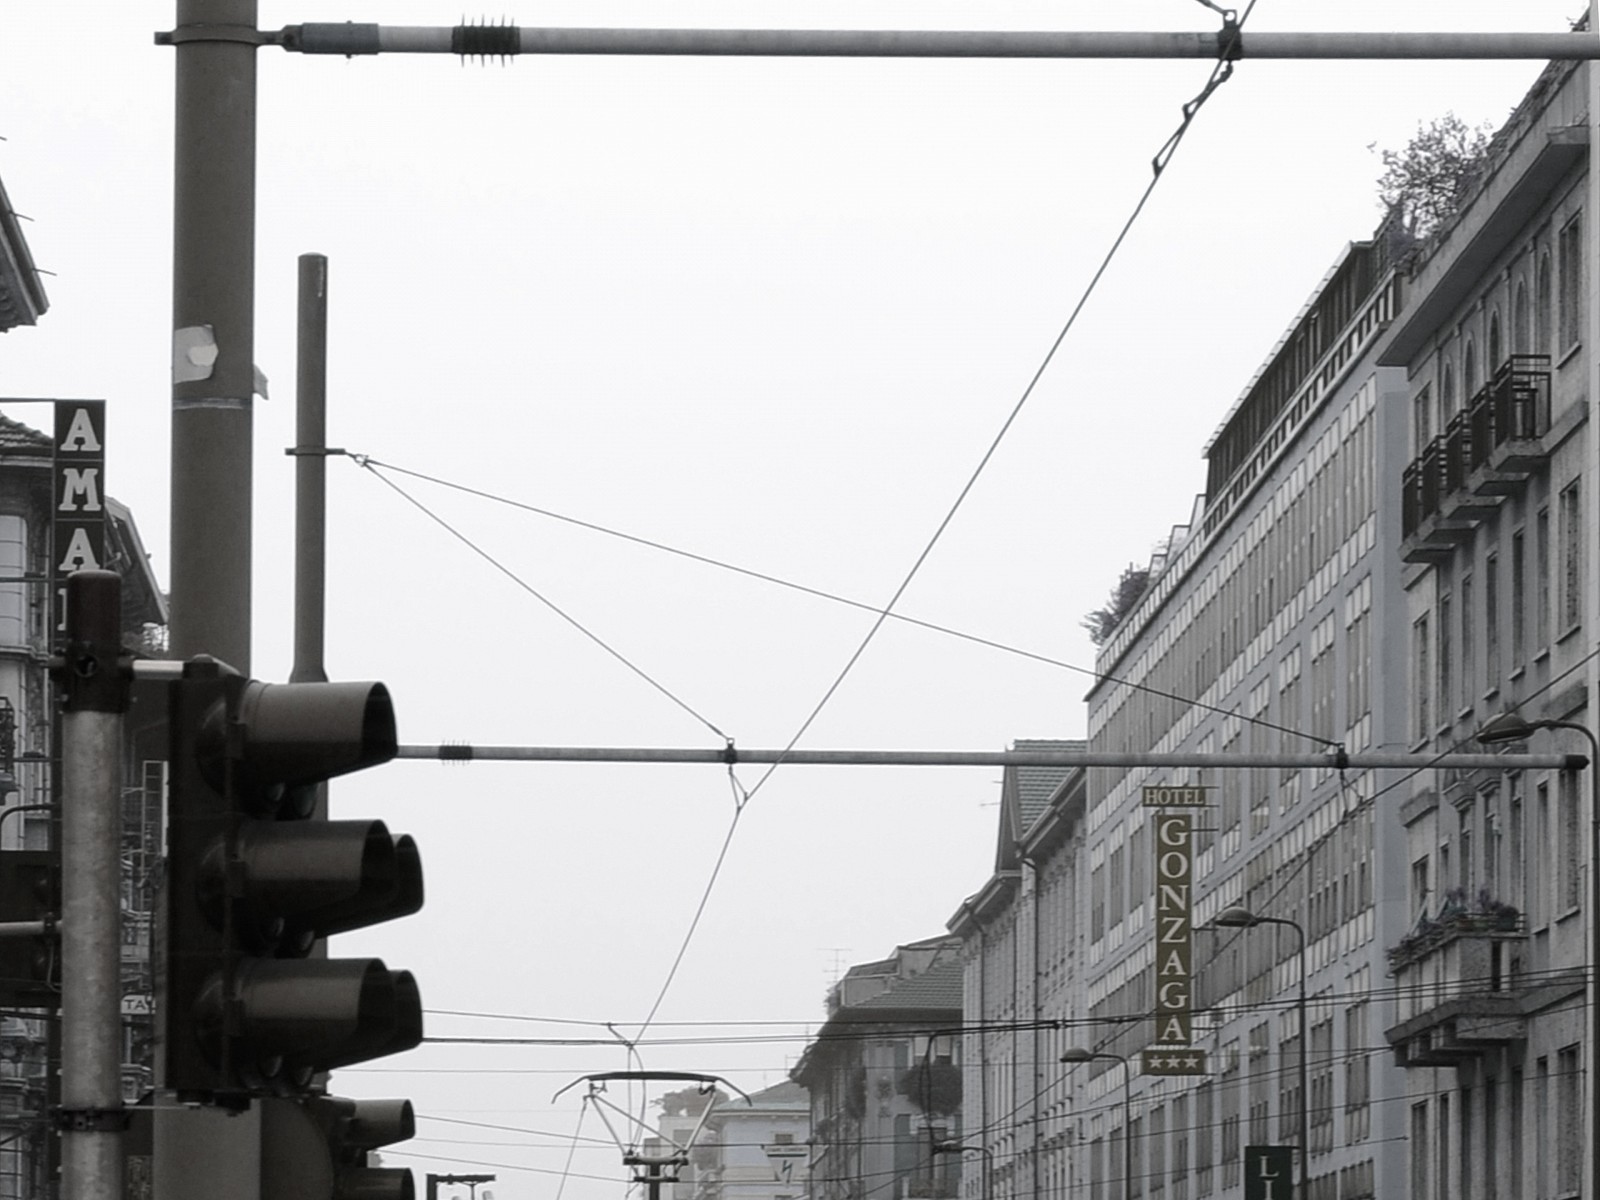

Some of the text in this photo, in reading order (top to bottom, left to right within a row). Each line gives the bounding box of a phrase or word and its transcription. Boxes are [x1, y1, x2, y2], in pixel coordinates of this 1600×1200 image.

[57, 408, 101, 631] AMA
[1144, 789, 1204, 804] HOTEL
[1159, 819, 1189, 1041] GONZAGA
